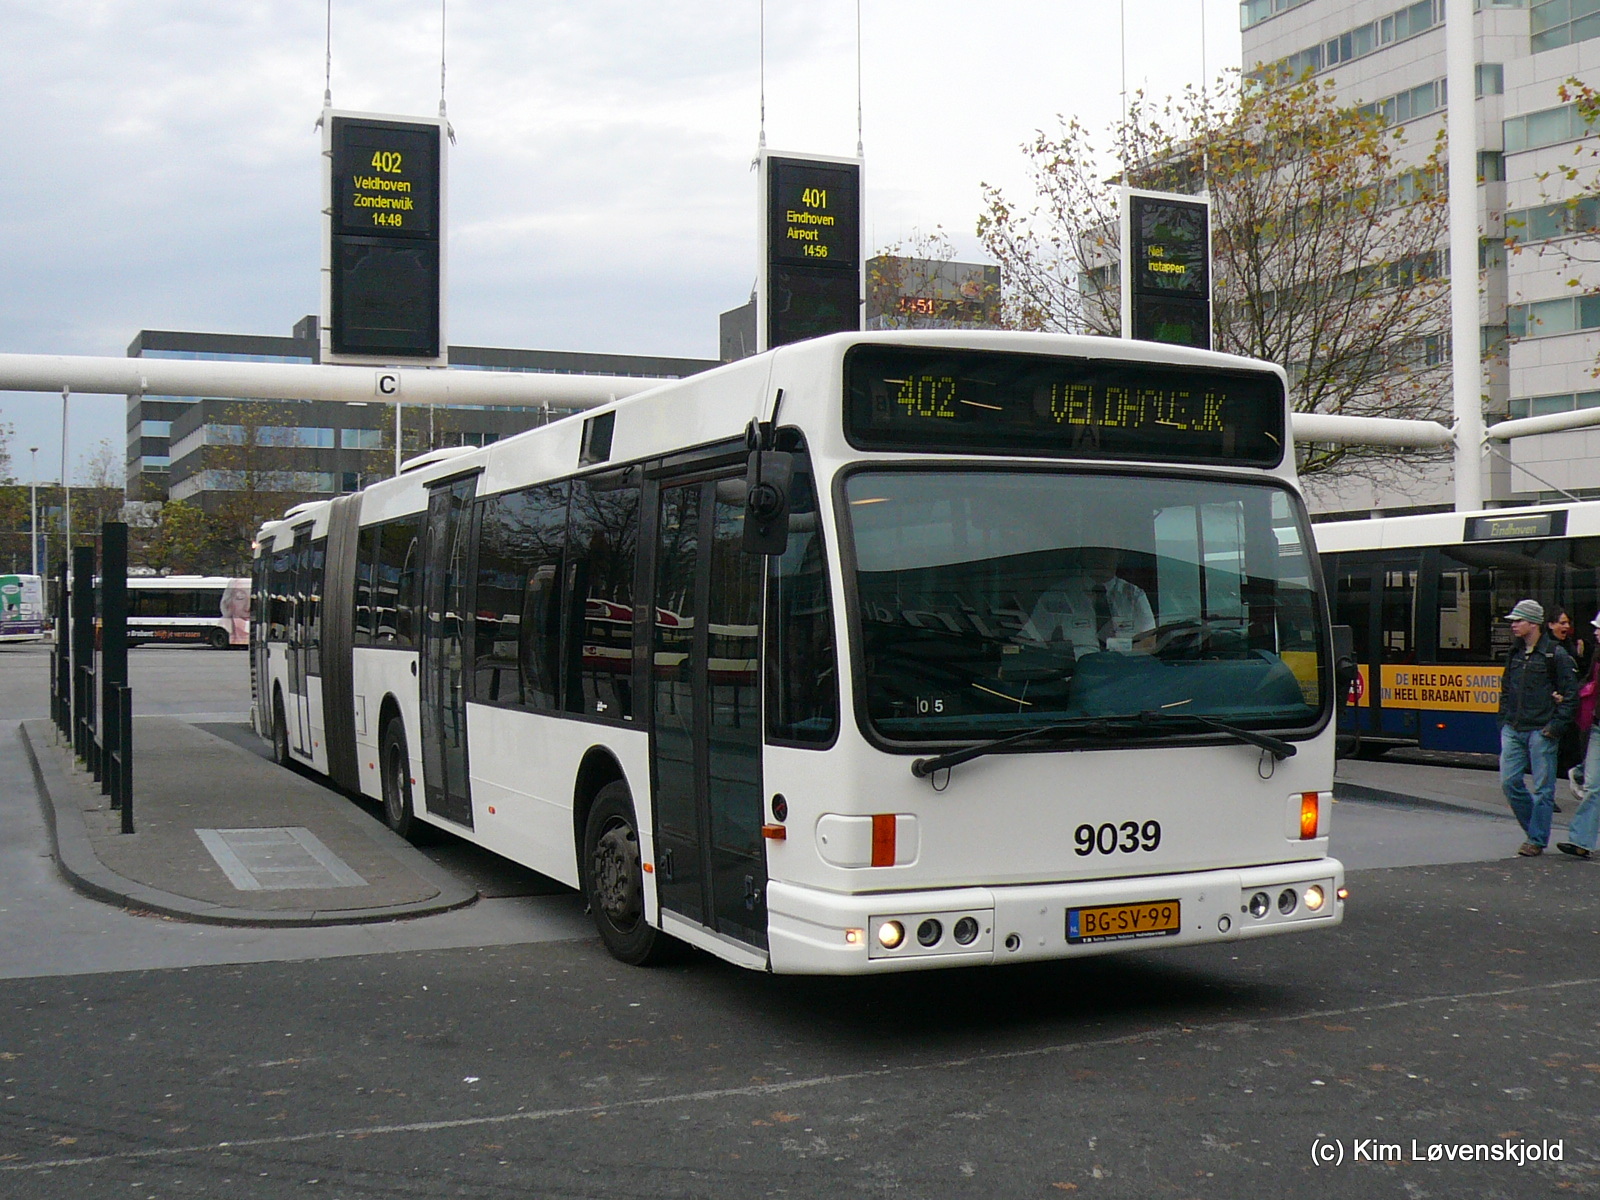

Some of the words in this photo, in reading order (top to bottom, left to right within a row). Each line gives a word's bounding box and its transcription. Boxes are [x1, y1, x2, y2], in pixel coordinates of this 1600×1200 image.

[372, 151, 402, 173] 402
[353, 175, 411, 192] Veldhoven
[353, 193, 414, 210] Zonderwijk
[802, 188, 827, 208] 401
[372, 212, 402, 227] 14:48
[786, 210, 835, 226] Eindhoven
[787, 226, 819, 240] Airport
[803, 244, 828, 257] 14:56
[380, 375, 396, 394] C
[898, 375, 955, 417] 402
[1491, 523, 1537, 536] Eindhoven
[1396, 673, 1409, 686] DE
[1412, 674, 1437, 686] HELE
[1440, 675, 1463, 687] DAG
[1381, 688, 1392, 700] IN
[1394, 688, 1418, 701] HEEL
[1421, 689, 1471, 703] BRABANT
[1474, 690, 1501, 704] VOO
[1074, 820, 1161, 856] 9039
[1085, 906, 1172, 933] BG-SV-99
